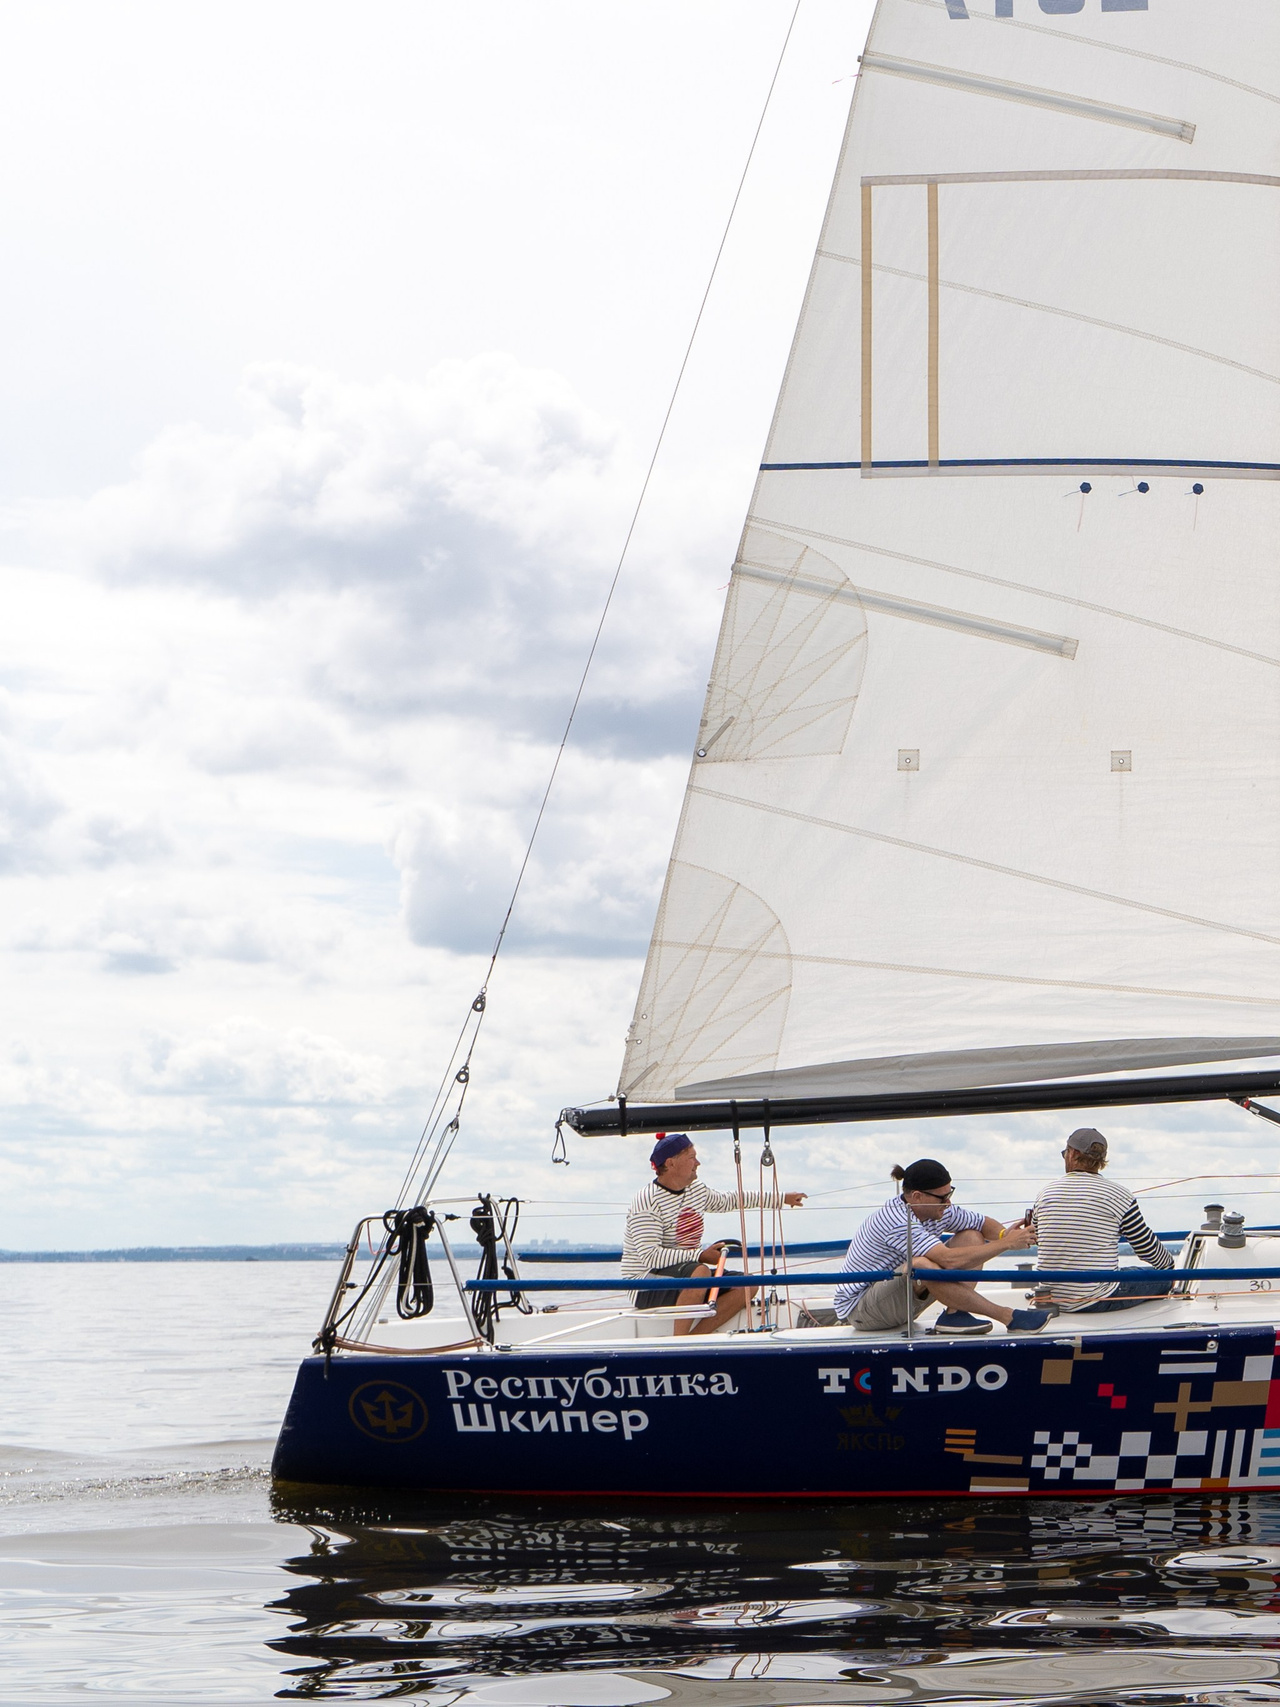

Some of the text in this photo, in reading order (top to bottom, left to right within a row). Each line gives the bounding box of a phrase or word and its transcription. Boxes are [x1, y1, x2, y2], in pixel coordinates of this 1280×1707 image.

[1249, 1279, 1272, 1292] 30
[441, 1366, 739, 1408] Республика
[452, 1402, 650, 1441] Шкипер
